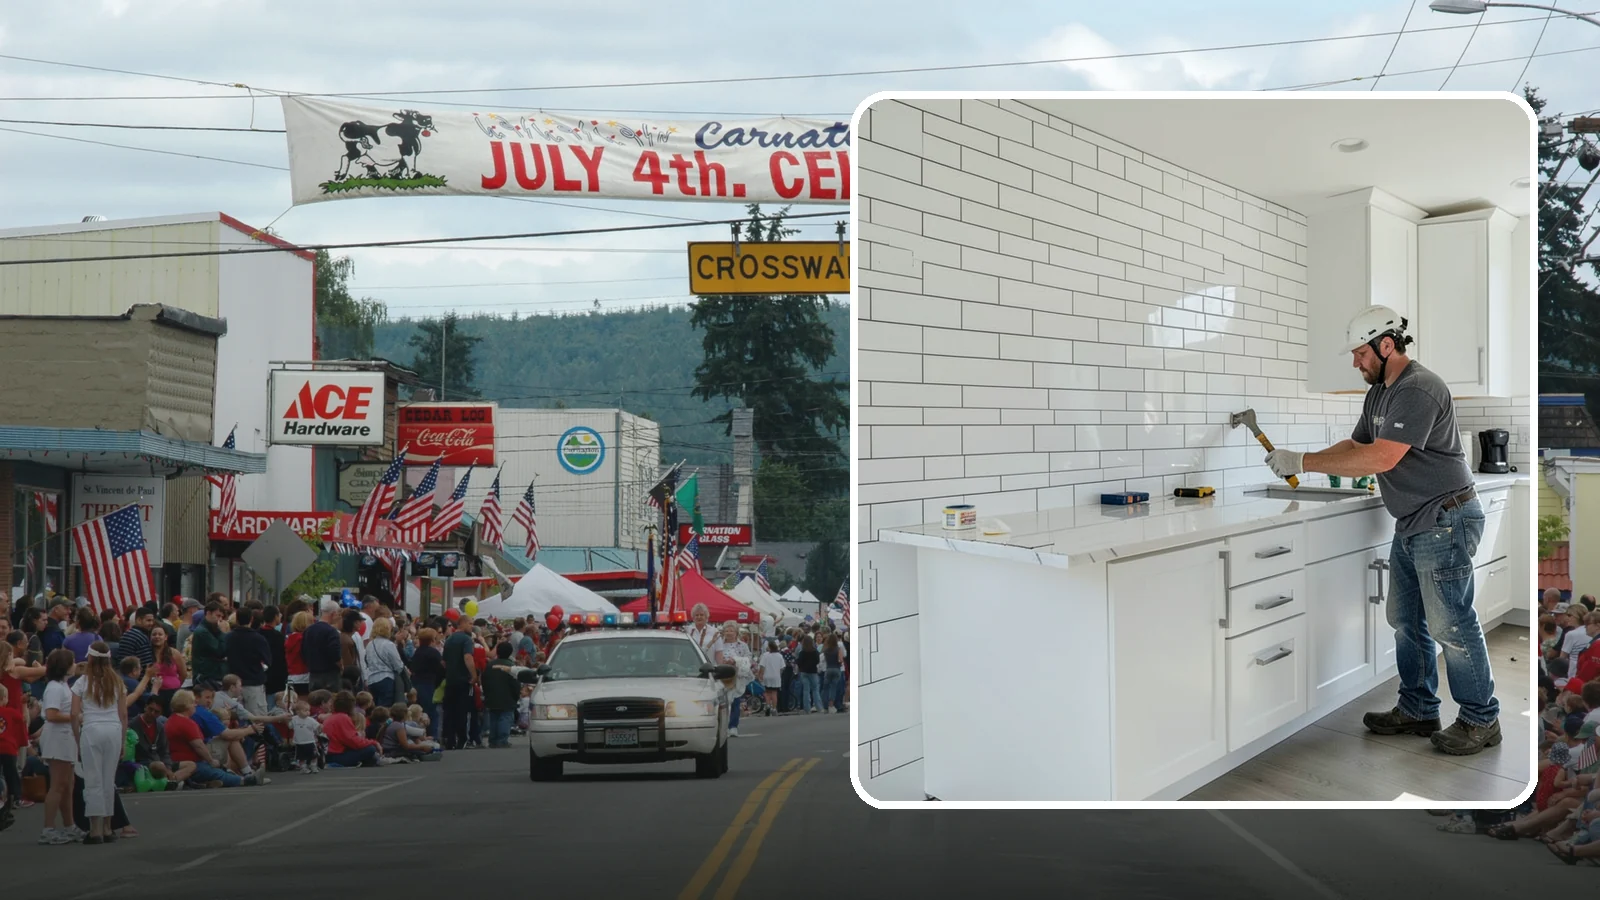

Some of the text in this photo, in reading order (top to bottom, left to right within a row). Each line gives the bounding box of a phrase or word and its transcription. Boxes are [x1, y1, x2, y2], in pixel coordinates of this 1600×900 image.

[481, 141, 603, 192] JULY
[632, 150, 746, 198] 4th.
[696, 253, 850, 280] CROSSWA
[283, 380, 373, 420] ACE
[405, 409, 485, 421] CEDAR LOG
[283, 421, 371, 436] Hardware
[416, 428, 477, 447] Coca-Cola
[83, 484, 155, 495] St. Vincent de Paul
[688, 526, 741, 535] CRNATION
[698, 535, 730, 543] GLASS
